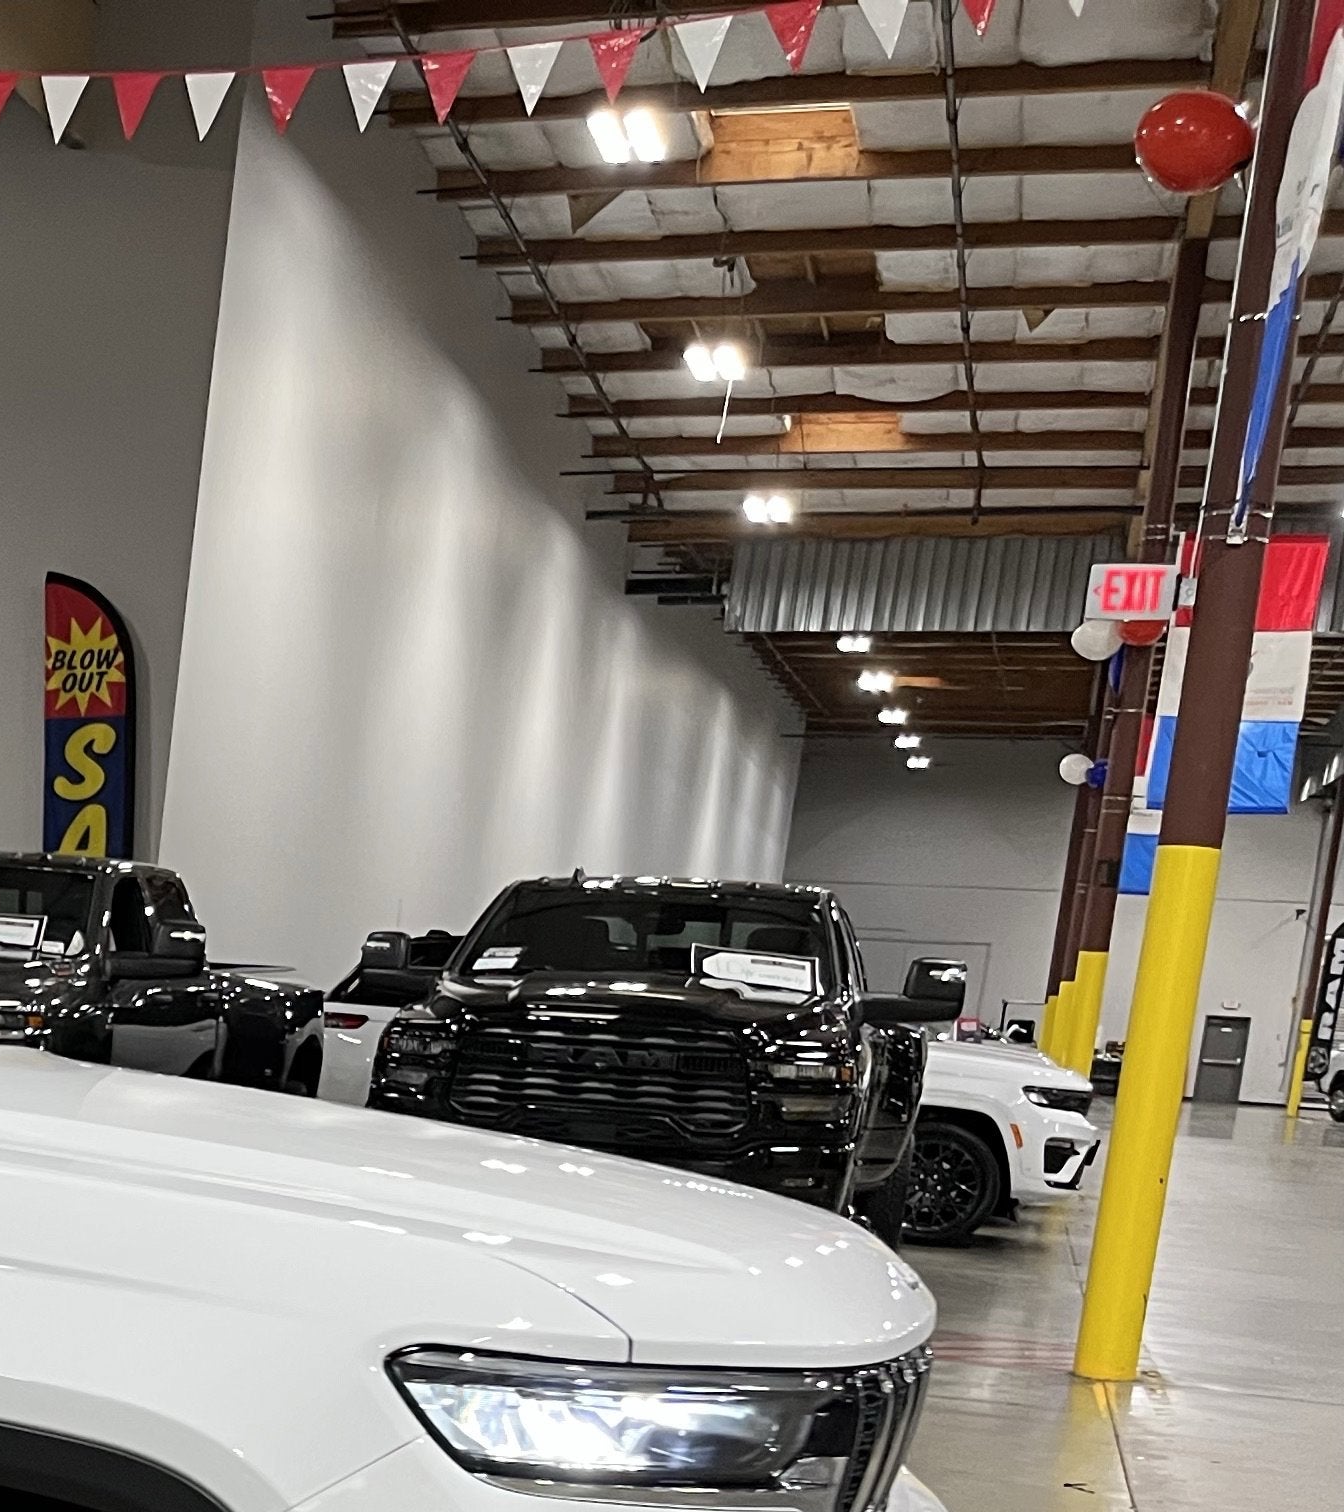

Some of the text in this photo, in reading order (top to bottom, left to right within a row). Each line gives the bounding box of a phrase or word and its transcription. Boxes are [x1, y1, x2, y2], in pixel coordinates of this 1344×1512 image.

[1101, 569, 1167, 613] EXIT
[52, 649, 119, 671] BLOW
[62, 671, 108, 693] OUT
